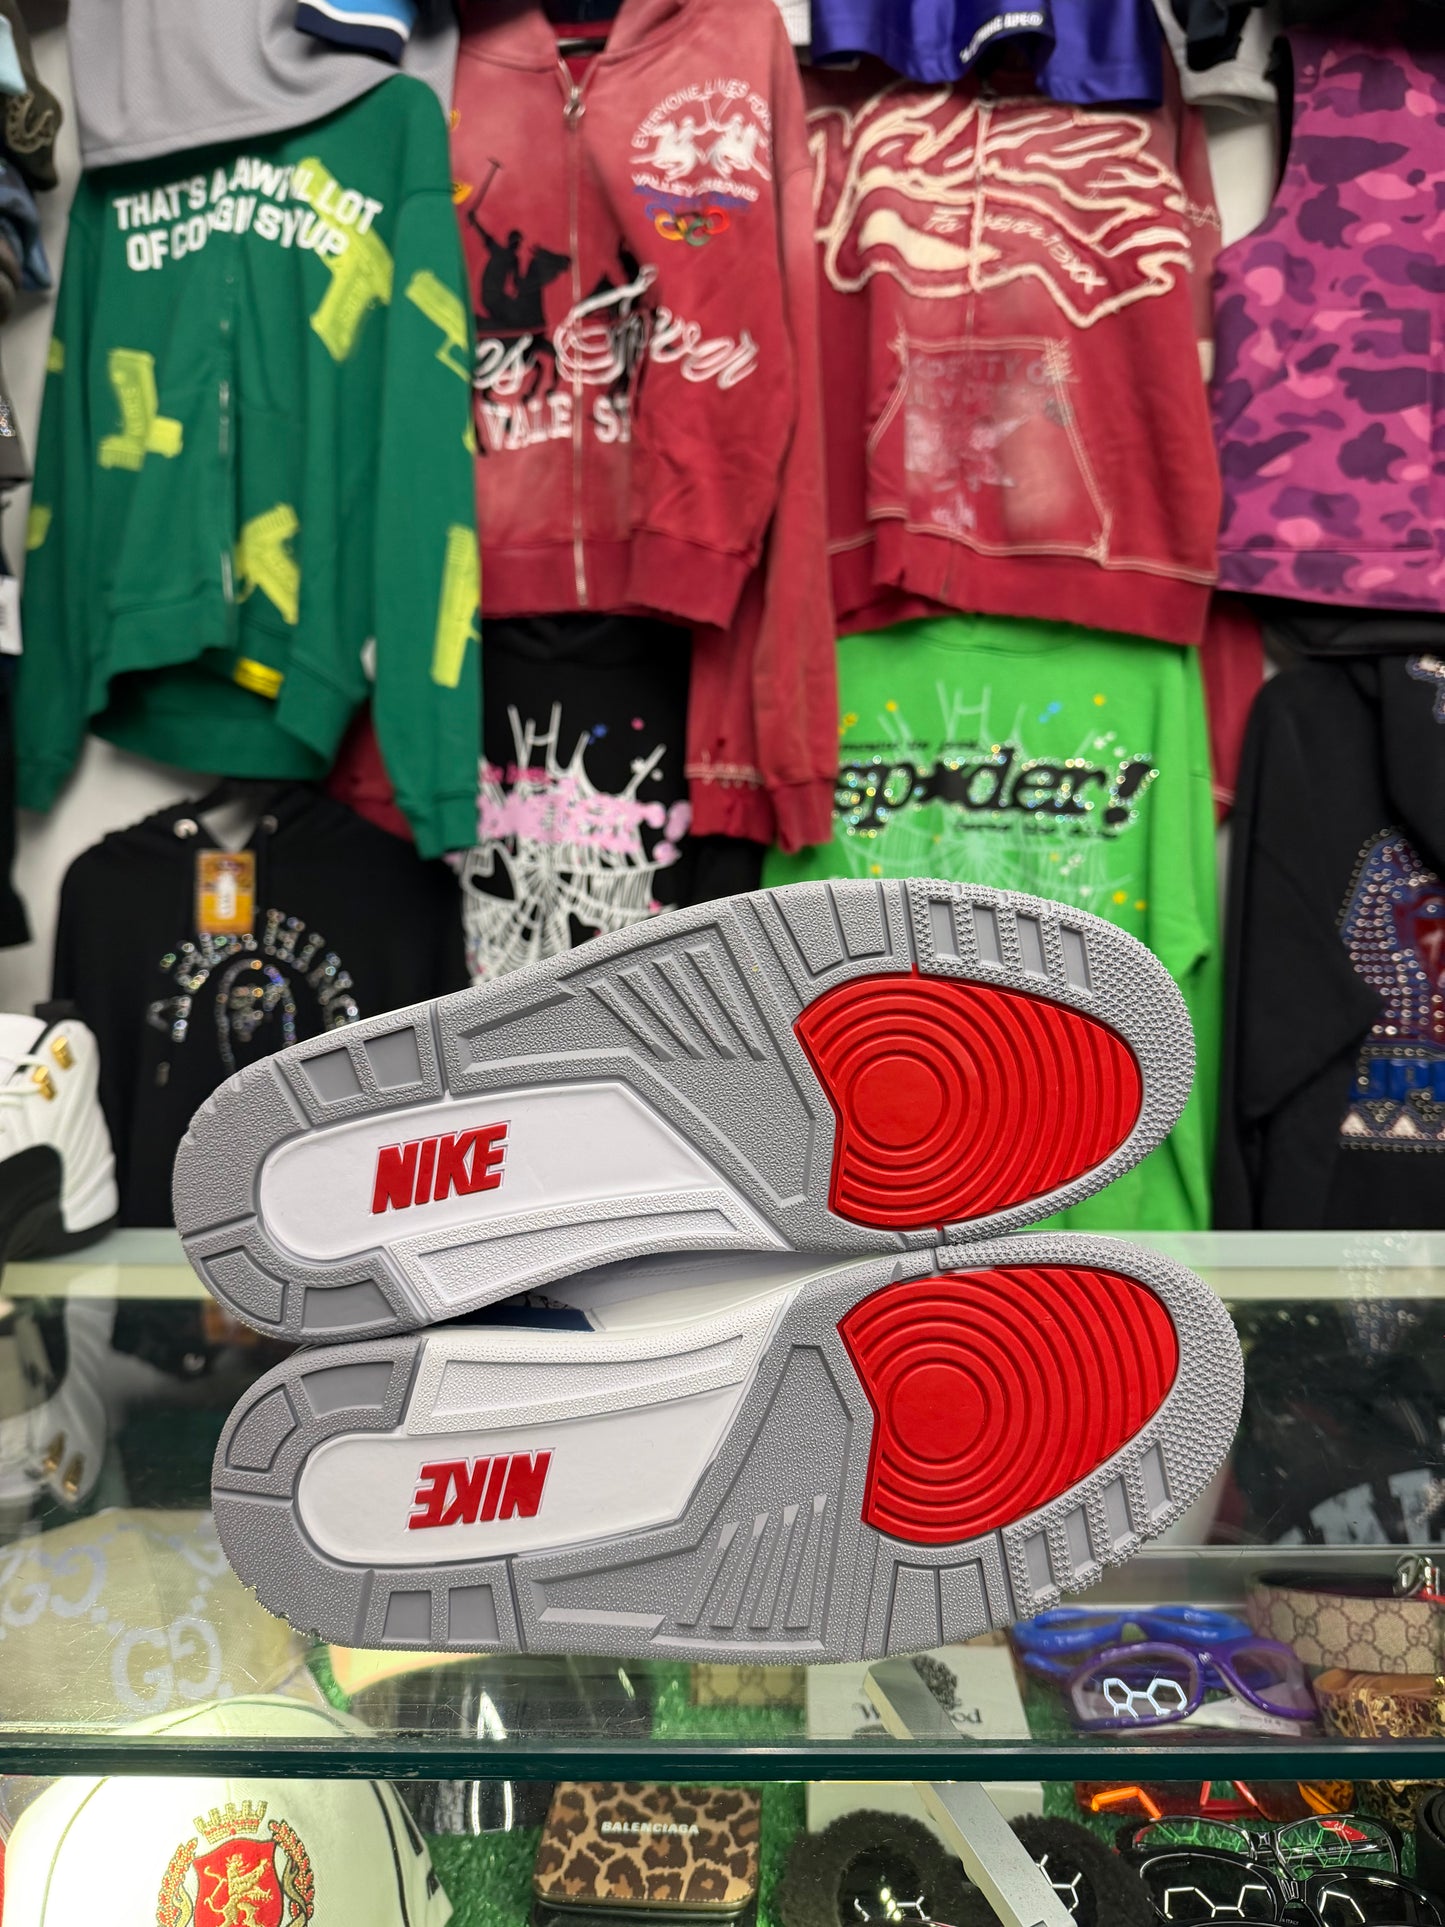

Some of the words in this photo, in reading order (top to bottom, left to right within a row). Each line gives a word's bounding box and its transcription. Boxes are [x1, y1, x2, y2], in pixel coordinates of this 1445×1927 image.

[631, 84, 699, 149] EVERYONE
[112, 176, 207, 230] THAT'S
[209, 167, 228, 204] A
[315, 180, 384, 234] LOT
[126, 229, 169, 271] OF
[838, 747, 1154, 828] spder!
[371, 1121, 511, 1215] NIKE
[408, 1449, 554, 1531] NIKE
[601, 1821, 699, 1835] BALENCIAGA
